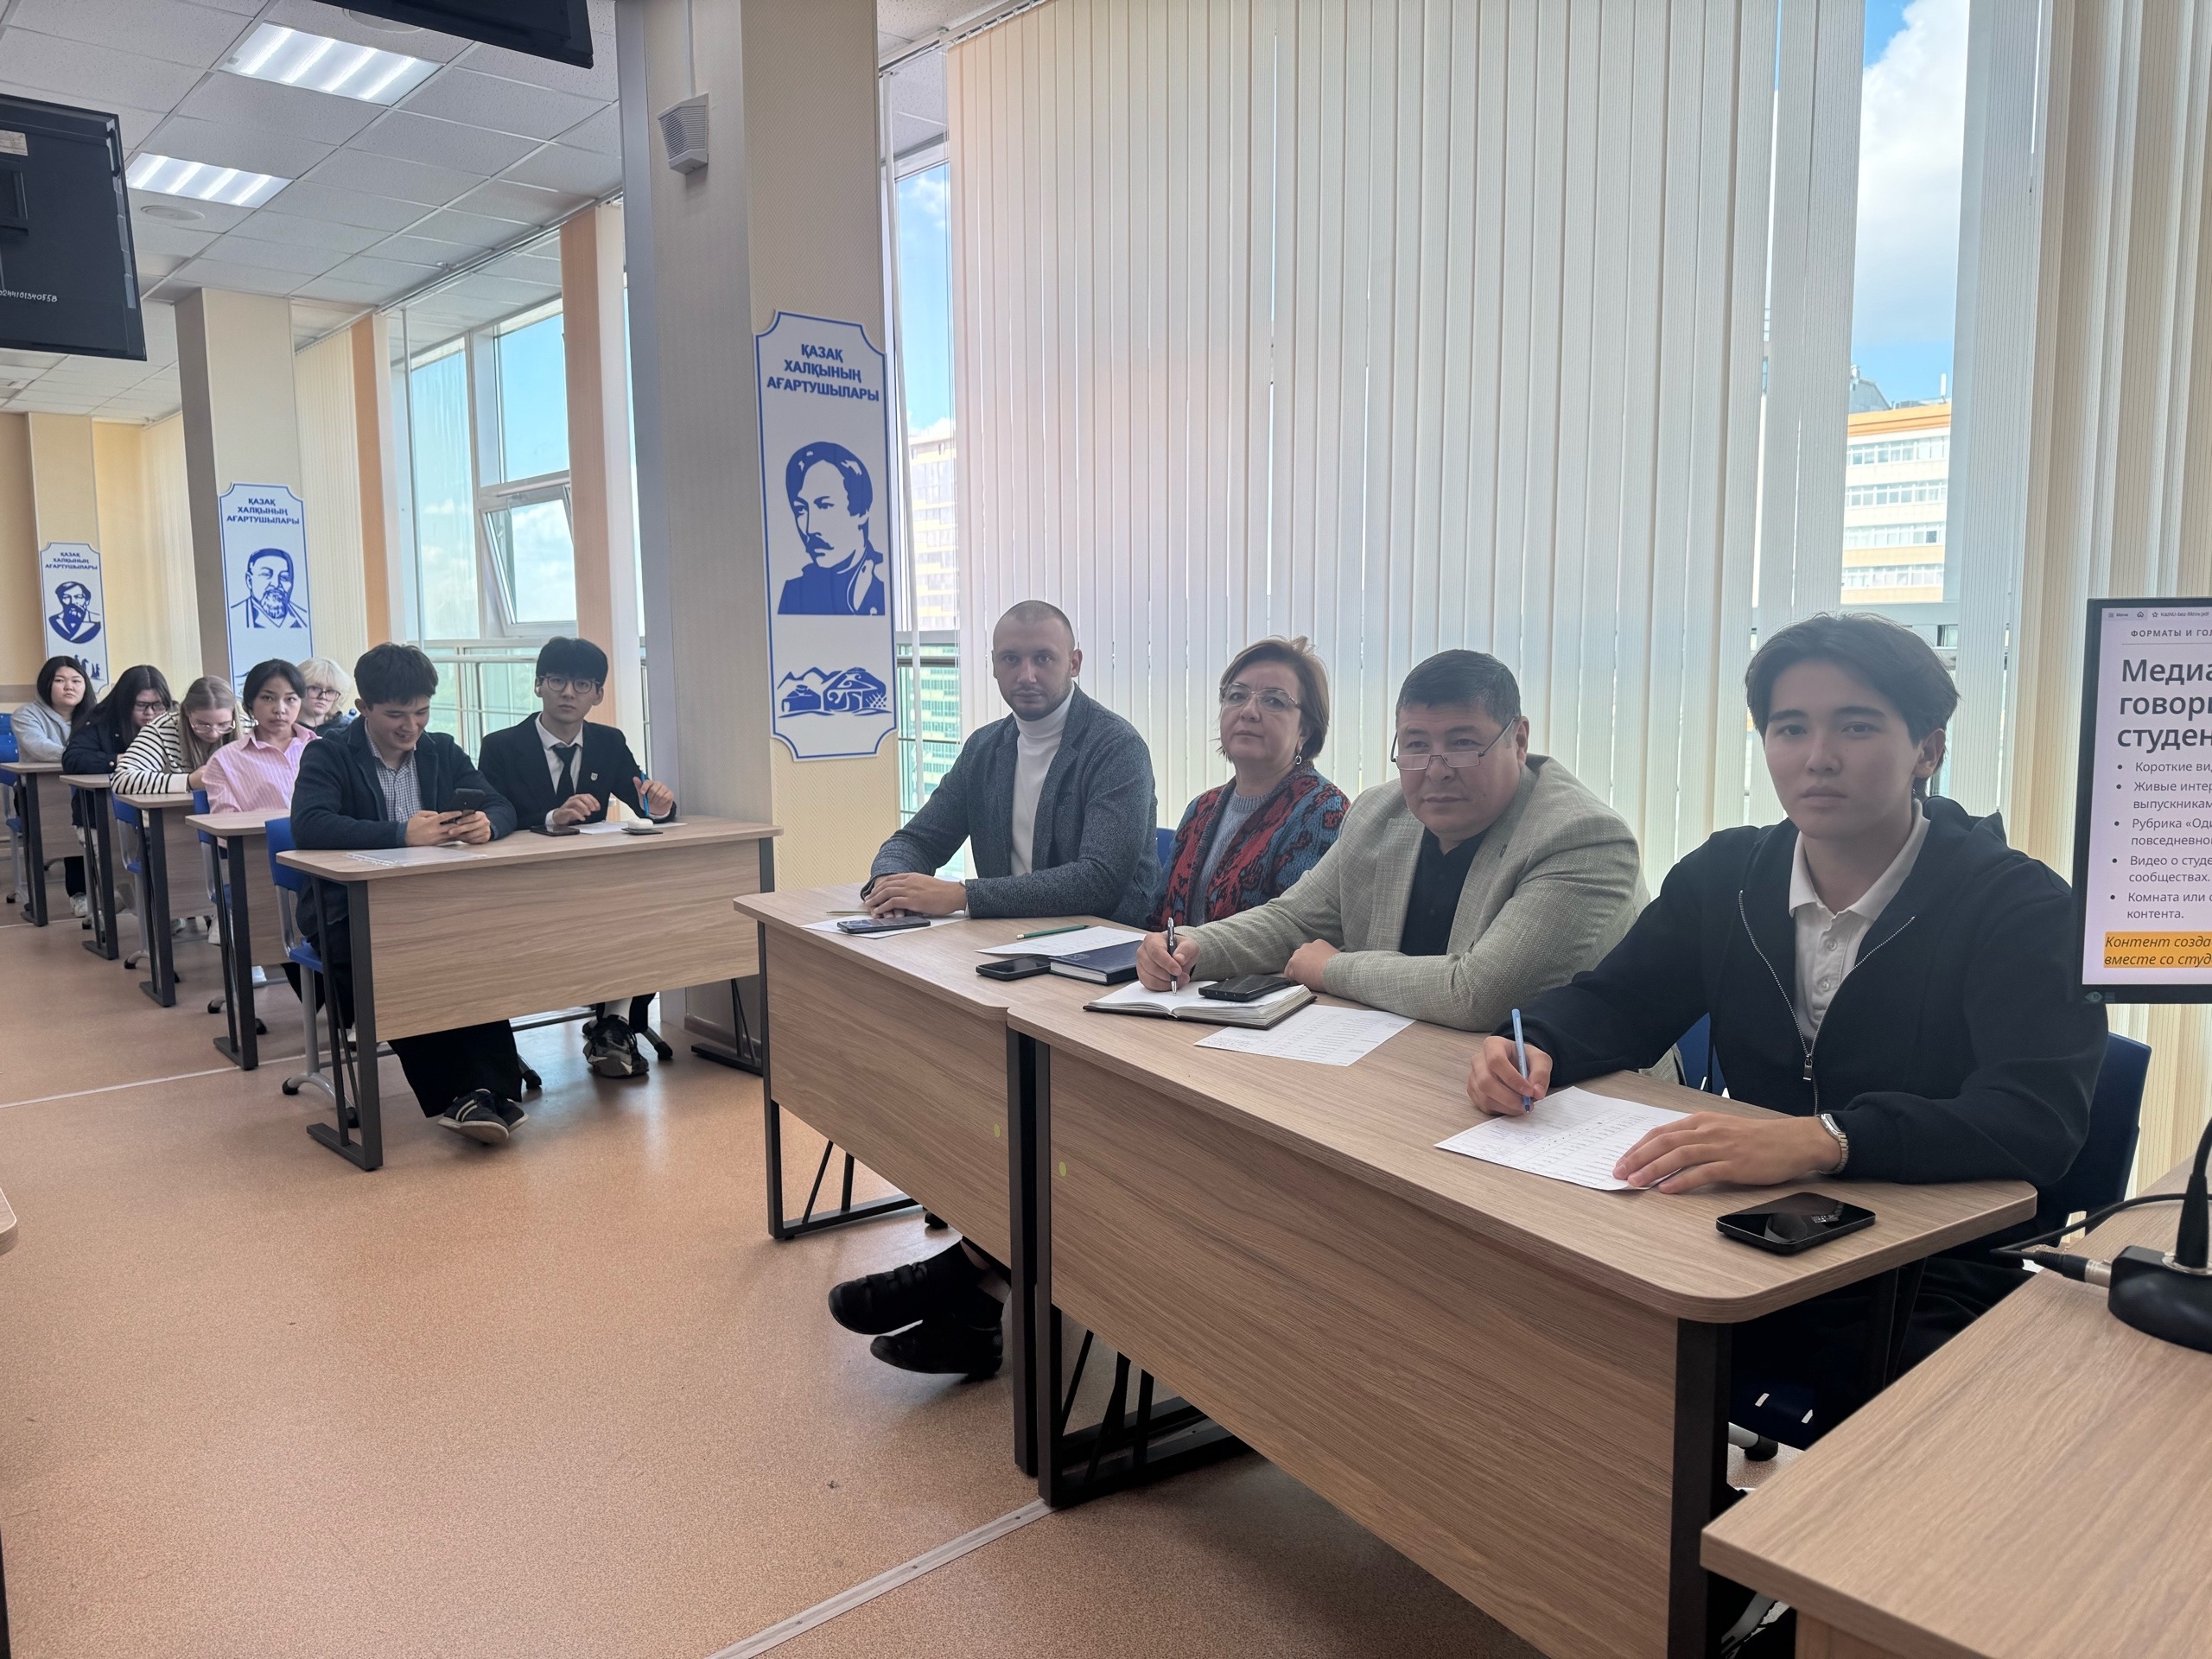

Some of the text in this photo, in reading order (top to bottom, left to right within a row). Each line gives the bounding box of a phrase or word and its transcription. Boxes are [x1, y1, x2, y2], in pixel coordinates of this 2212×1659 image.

[801, 344, 843, 363] ҚАЗАҚ
[784, 359, 862, 383] ХАЛҚЫНЫҢ
[766, 377, 880, 402] АҒАРТУШЫЛАРЫ
[248, 498, 276, 506] ҚАЗАҚ
[238, 506, 288, 516] ХАЛҚЫНЫҢ
[2131, 629, 2182, 638] ФОРМАТЫ
[2120, 696, 2212, 721] говор
[2117, 729, 2212, 753] студен
[2135, 762, 2212, 774] Короткие ви
[2133, 781, 2177, 791] Живые
[2133, 818, 2182, 830] Рубрика
[2131, 837, 2212, 847] повседневно
[2130, 855, 2167, 867] Видео
[2129, 871, 2210, 883] сообществах.
[2128, 892, 2179, 902] Комната
[2183, 893, 2205, 902] или
[2105, 936, 2212, 948] Контент созда
[2104, 953, 2212, 968] вместе со студ
